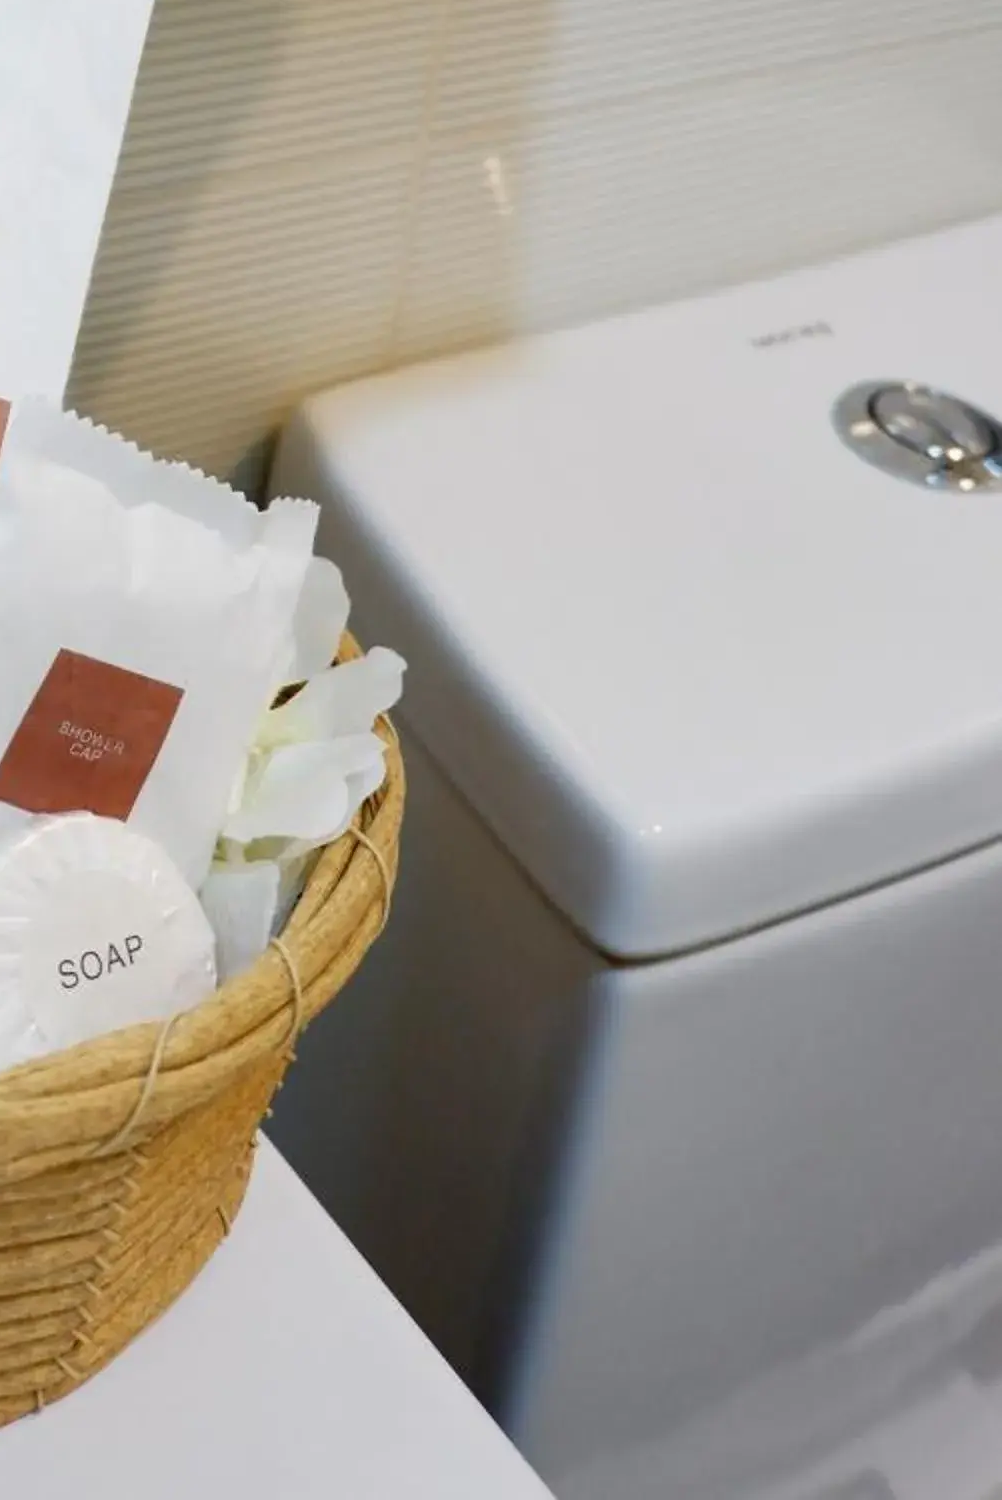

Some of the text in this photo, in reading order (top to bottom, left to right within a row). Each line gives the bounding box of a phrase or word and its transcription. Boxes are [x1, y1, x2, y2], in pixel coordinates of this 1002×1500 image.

[58, 720, 125, 755] SHOWER
[69, 742, 103, 761] CAP
[58, 934, 143, 989] SOAP
